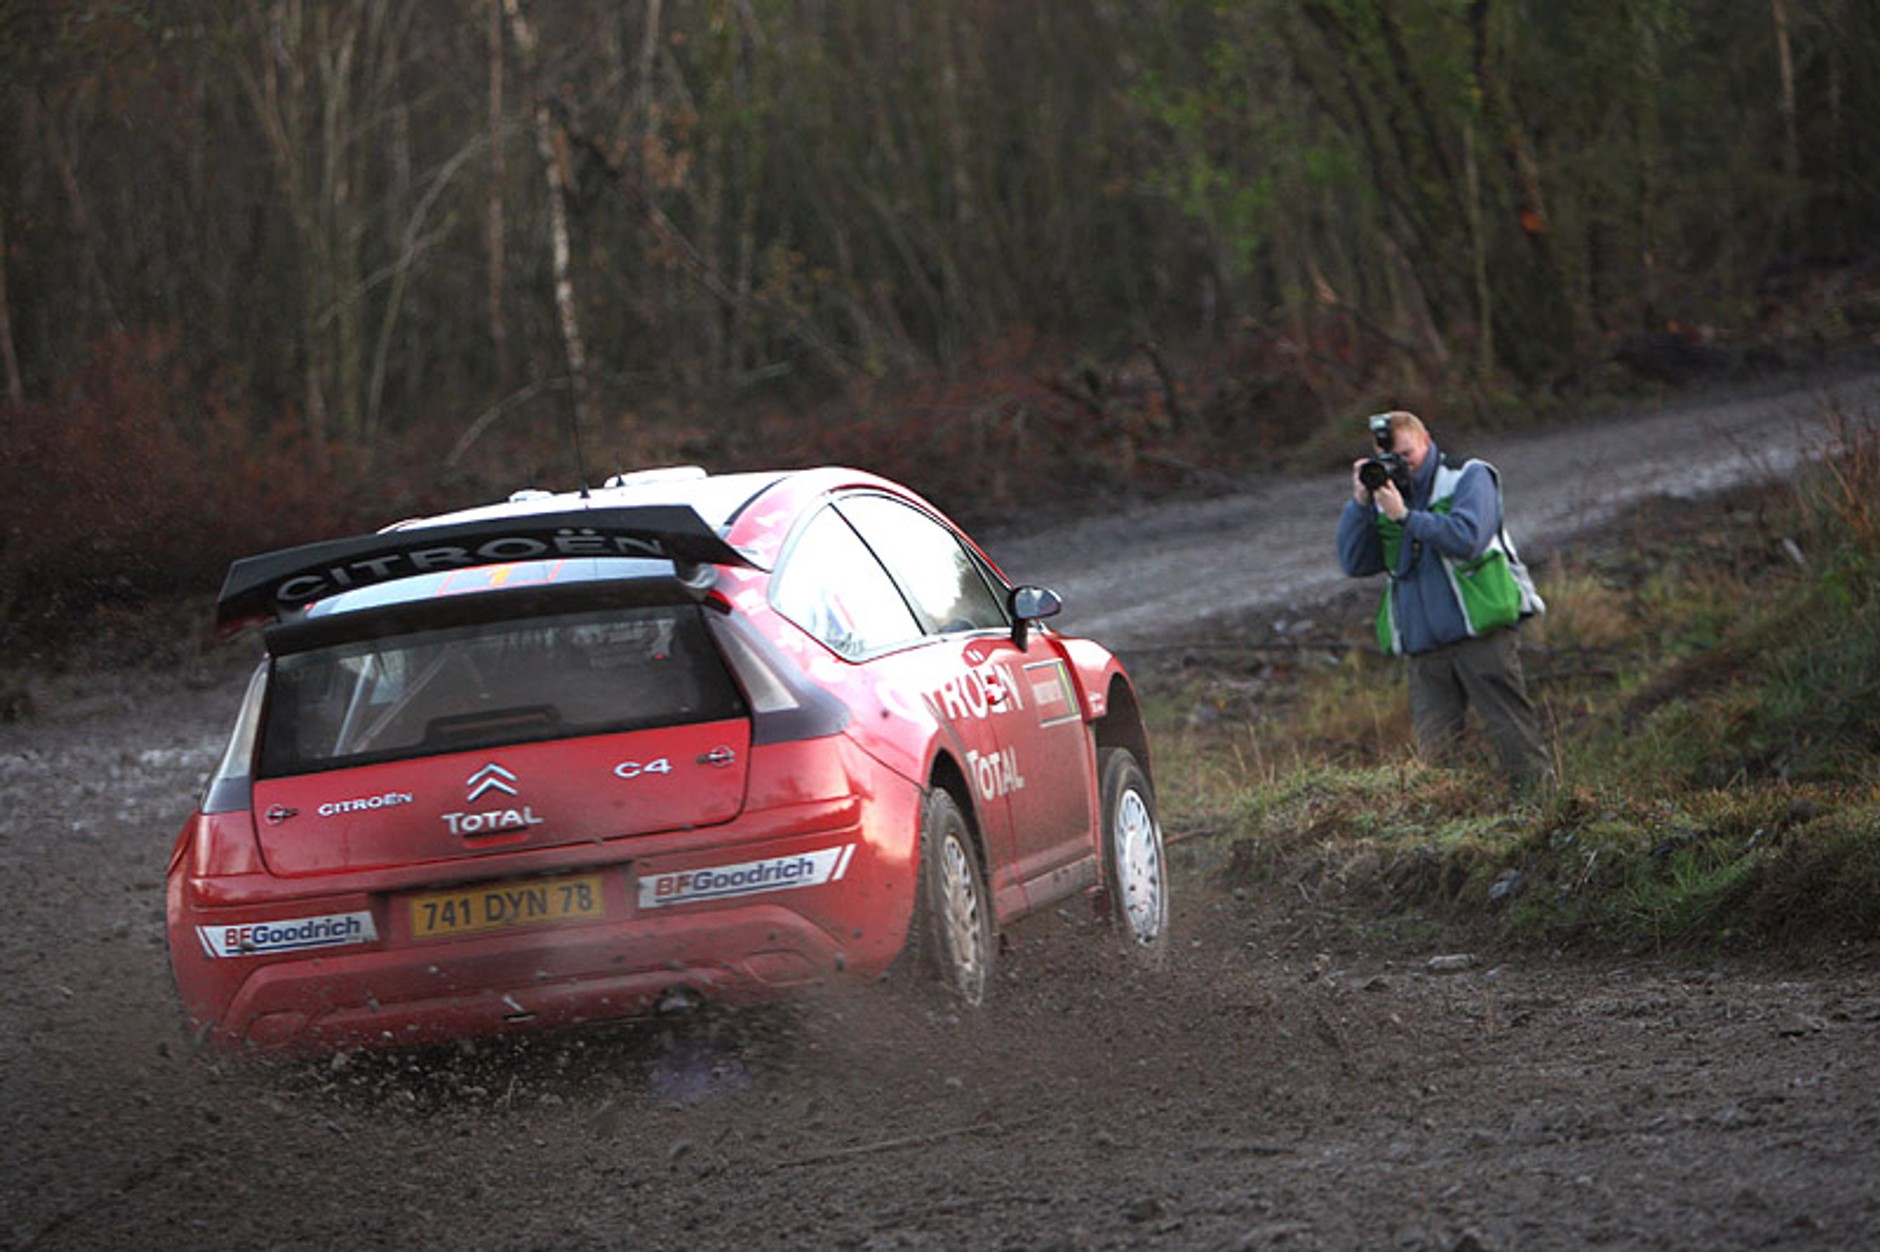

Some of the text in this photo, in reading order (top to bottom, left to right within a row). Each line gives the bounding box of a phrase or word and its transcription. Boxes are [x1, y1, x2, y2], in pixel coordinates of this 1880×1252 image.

[275, 526, 664, 604] CITROËN
[614, 757, 671, 780] C4
[966, 746, 1025, 802] TOTAL
[317, 791, 414, 819] CITROËN
[440, 806, 544, 836] TOTAL
[655, 857, 815, 898] BFGoodrich
[422, 881, 594, 932] 741 DYN 78
[225, 914, 361, 947] BFGoodrich
